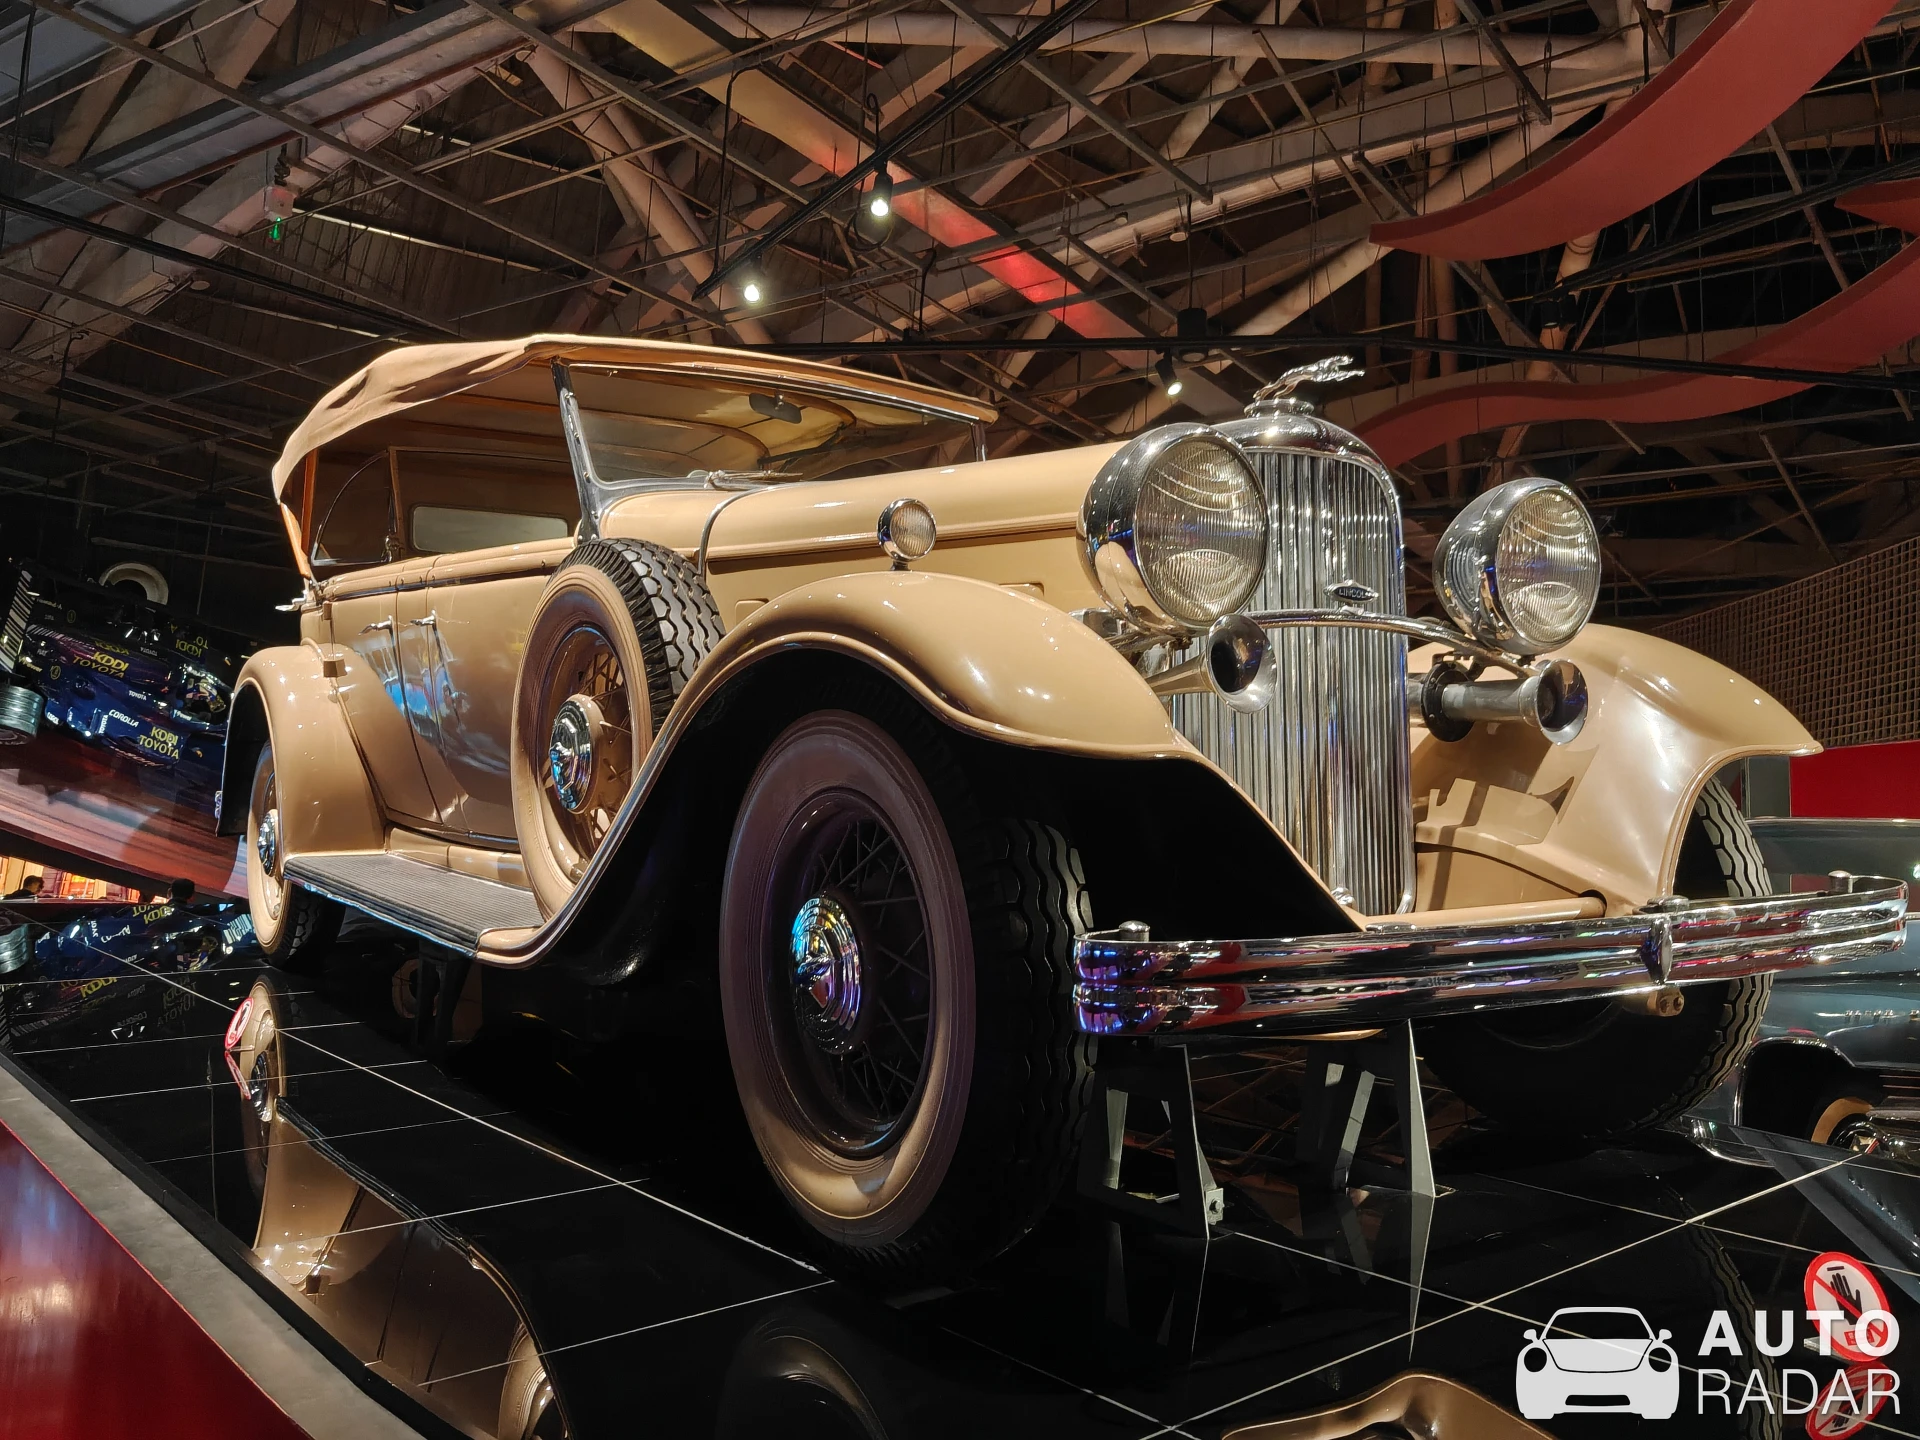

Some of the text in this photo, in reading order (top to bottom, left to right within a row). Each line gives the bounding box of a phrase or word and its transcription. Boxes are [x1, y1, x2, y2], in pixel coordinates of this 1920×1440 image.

[72, 654, 125, 678] TOYOTA
[93, 651, 129, 671] KDDI
[108, 709, 140, 728] COROLLA
[139, 734, 180, 760] TOYOTA
[151, 726, 179, 747] KDDI
